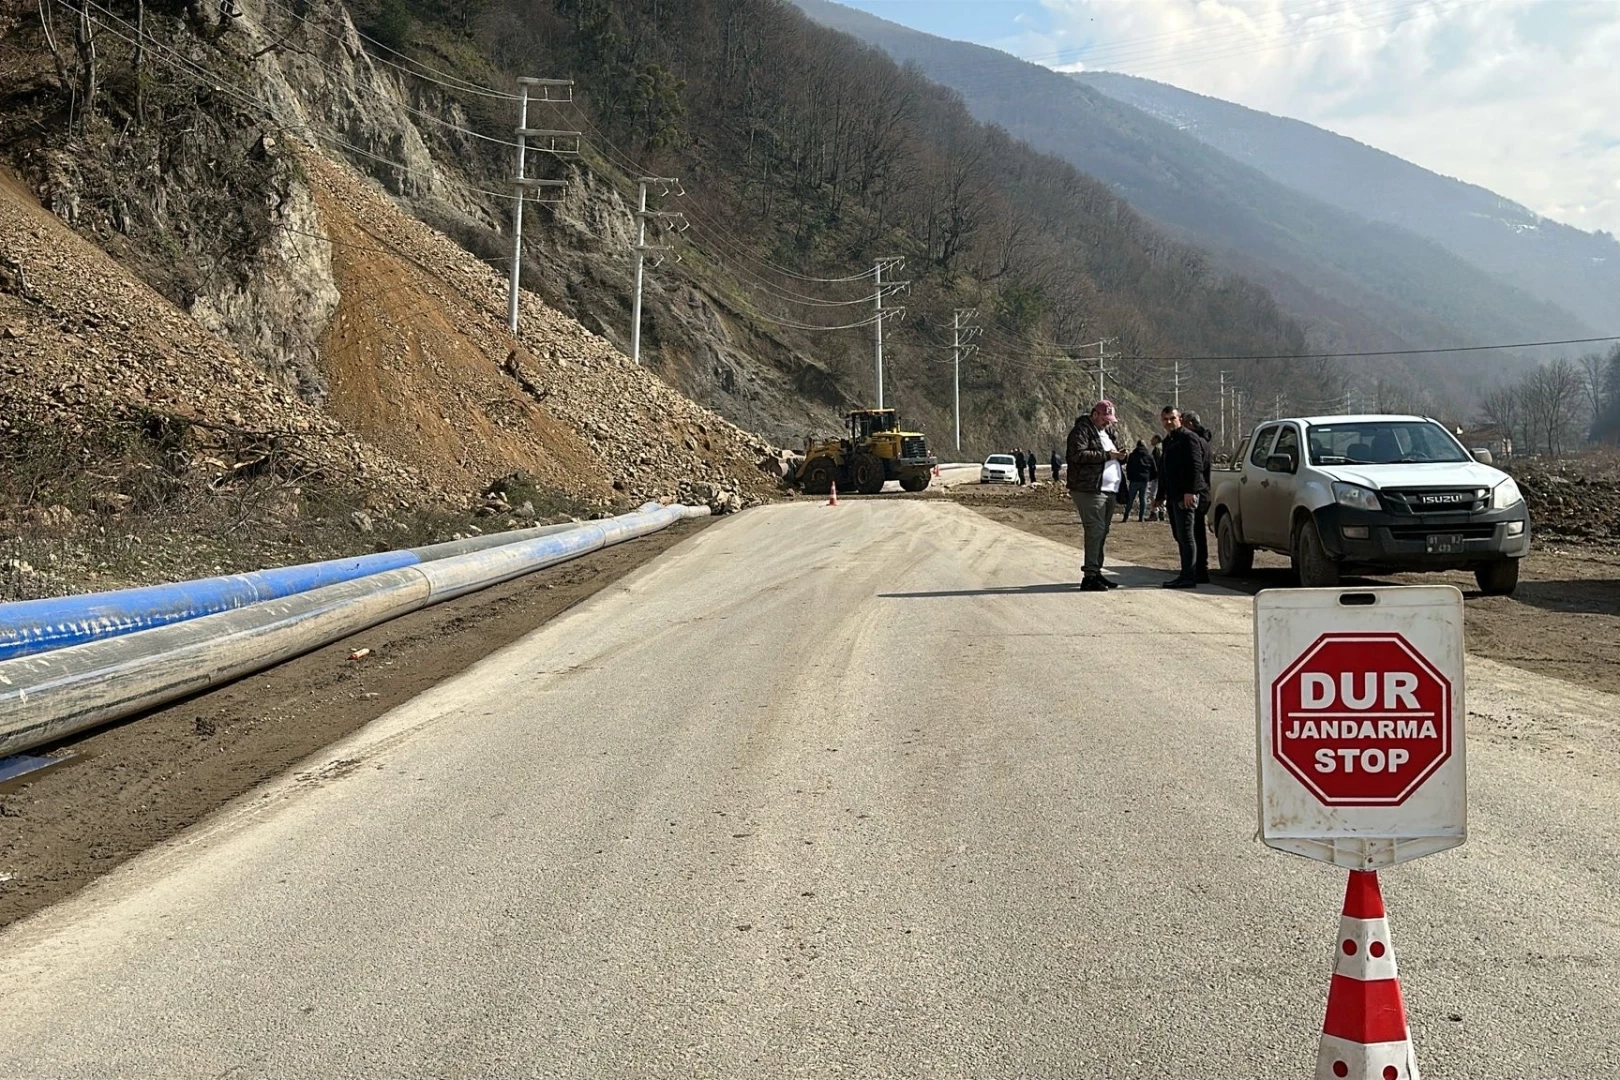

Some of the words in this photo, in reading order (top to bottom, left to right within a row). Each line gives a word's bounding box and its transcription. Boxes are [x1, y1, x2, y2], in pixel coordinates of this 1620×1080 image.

[1422, 496, 1459, 504] ISUZU
[1300, 671, 1421, 710] DUR
[1285, 720, 1437, 739] JANDARMA
[1314, 748, 1410, 774] STOP
